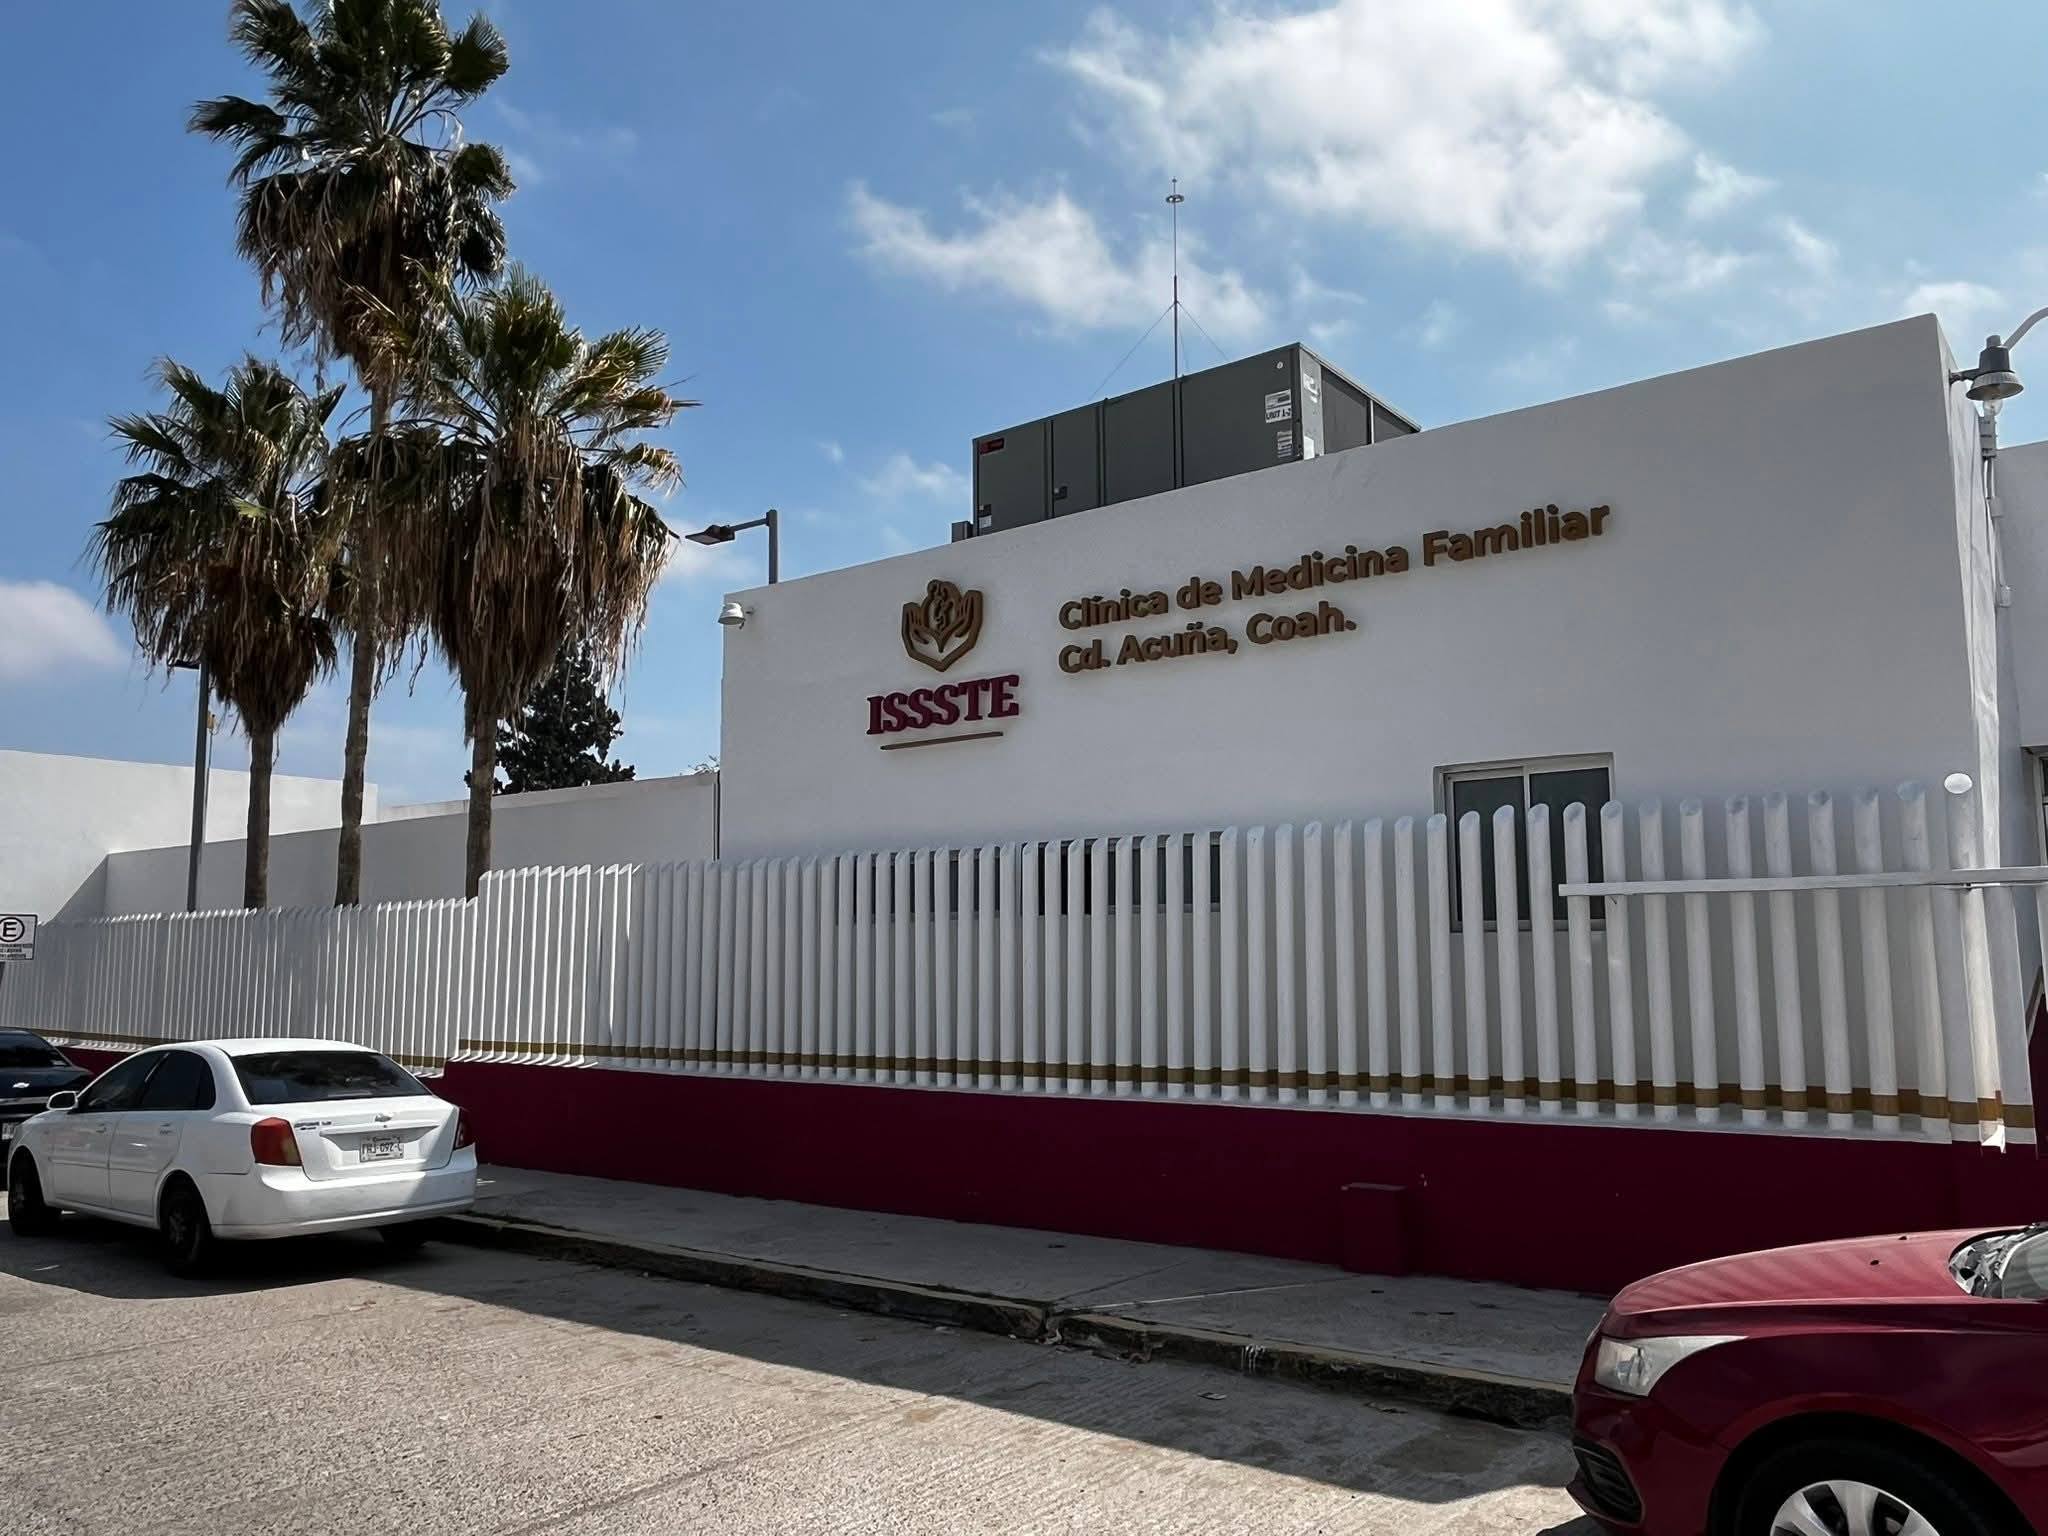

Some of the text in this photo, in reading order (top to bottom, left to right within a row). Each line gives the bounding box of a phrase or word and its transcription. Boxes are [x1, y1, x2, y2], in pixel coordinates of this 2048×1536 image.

[1059, 504, 1610, 630] Clínica de Medicina Familiar
[1058, 601, 1357, 673] Cd. Acuña, Coah.
[866, 674, 1020, 735] ISSSTE
[3, 921, 18, 937] E
